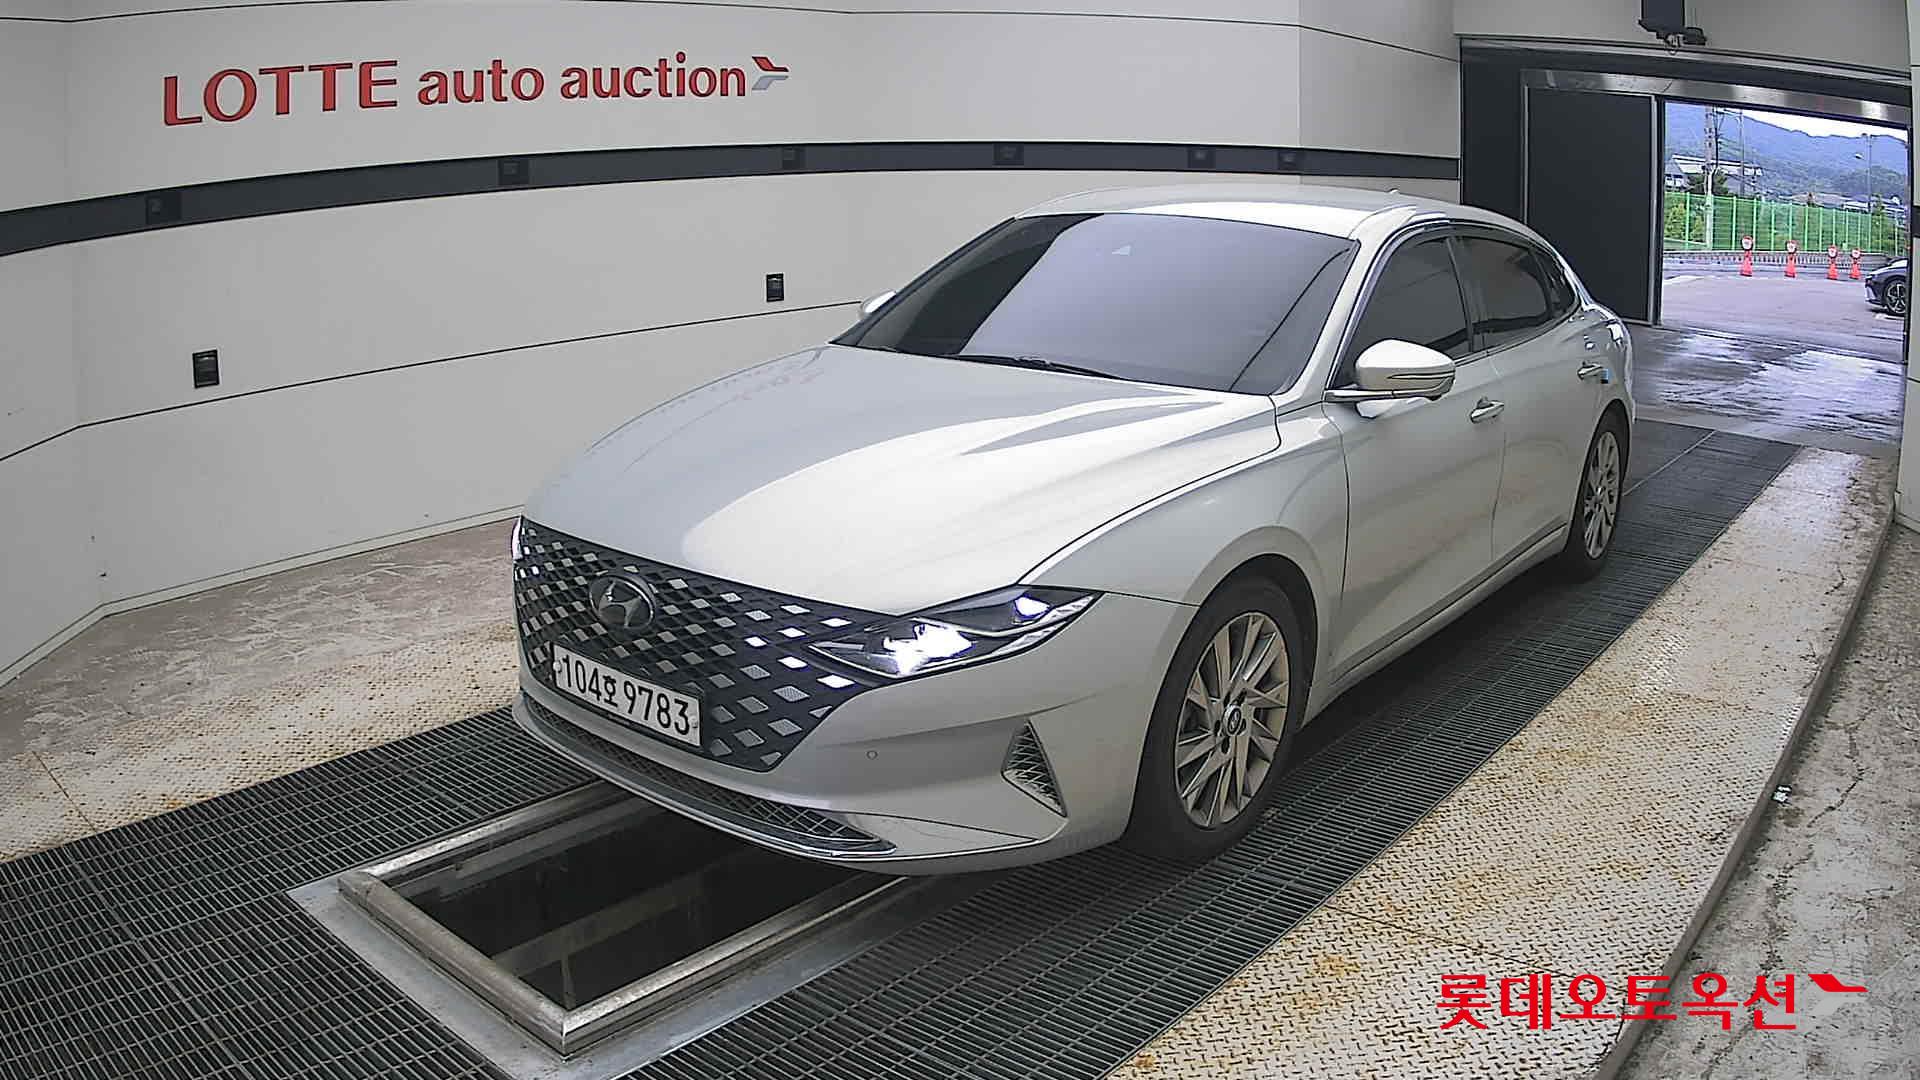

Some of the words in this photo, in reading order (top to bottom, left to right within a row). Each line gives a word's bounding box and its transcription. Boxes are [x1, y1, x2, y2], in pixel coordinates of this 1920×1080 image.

[163, 60, 398, 126] LOTTE
[418, 59, 545, 106] auto
[560, 51, 747, 99] auction
